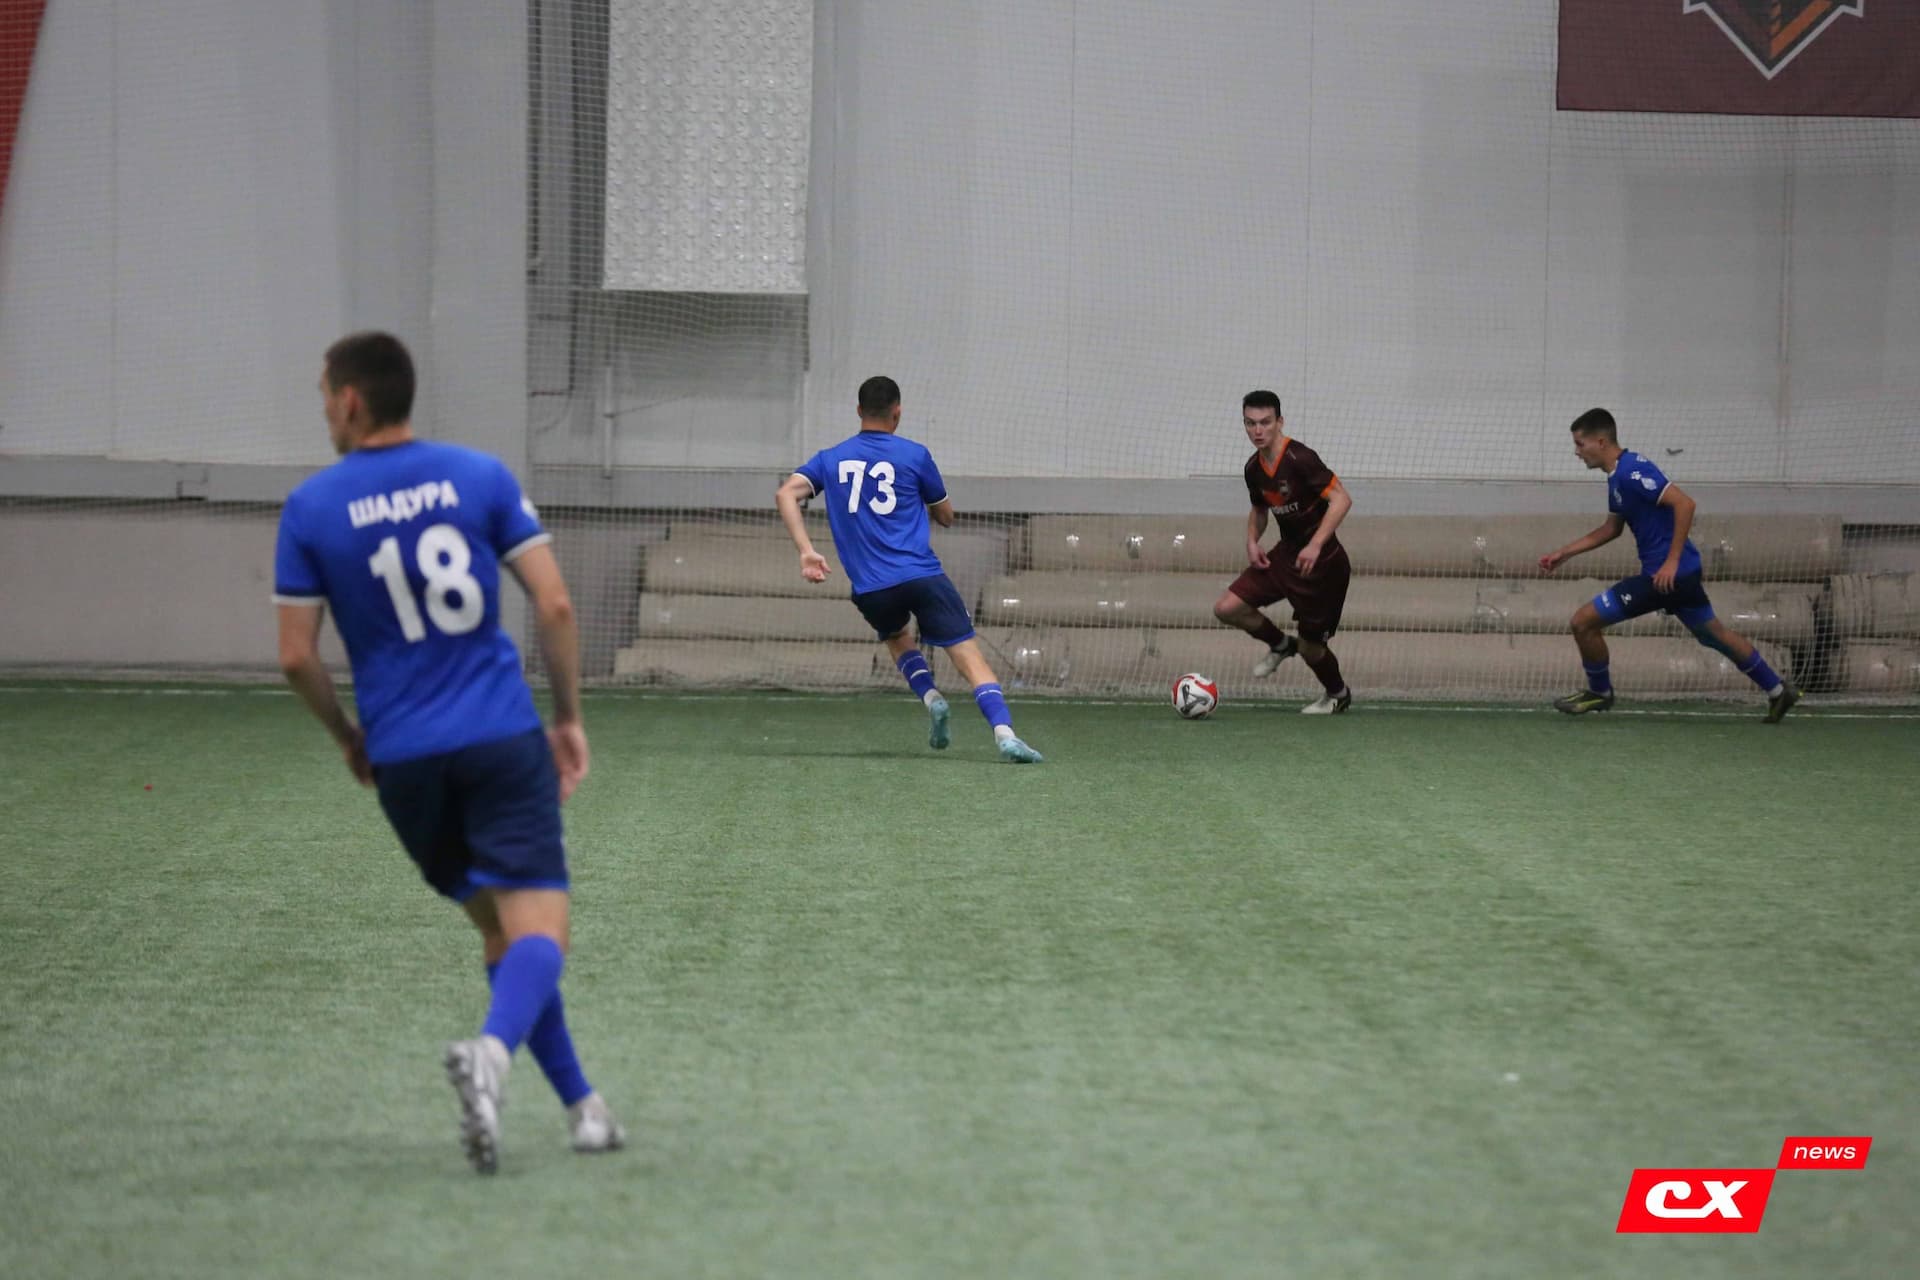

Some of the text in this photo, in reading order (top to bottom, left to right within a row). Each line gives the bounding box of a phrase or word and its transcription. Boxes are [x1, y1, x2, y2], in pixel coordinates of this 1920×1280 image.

[348, 480, 459, 528] ШАДУРА
[838, 460, 897, 515] 73
[368, 524, 484, 643] 18
